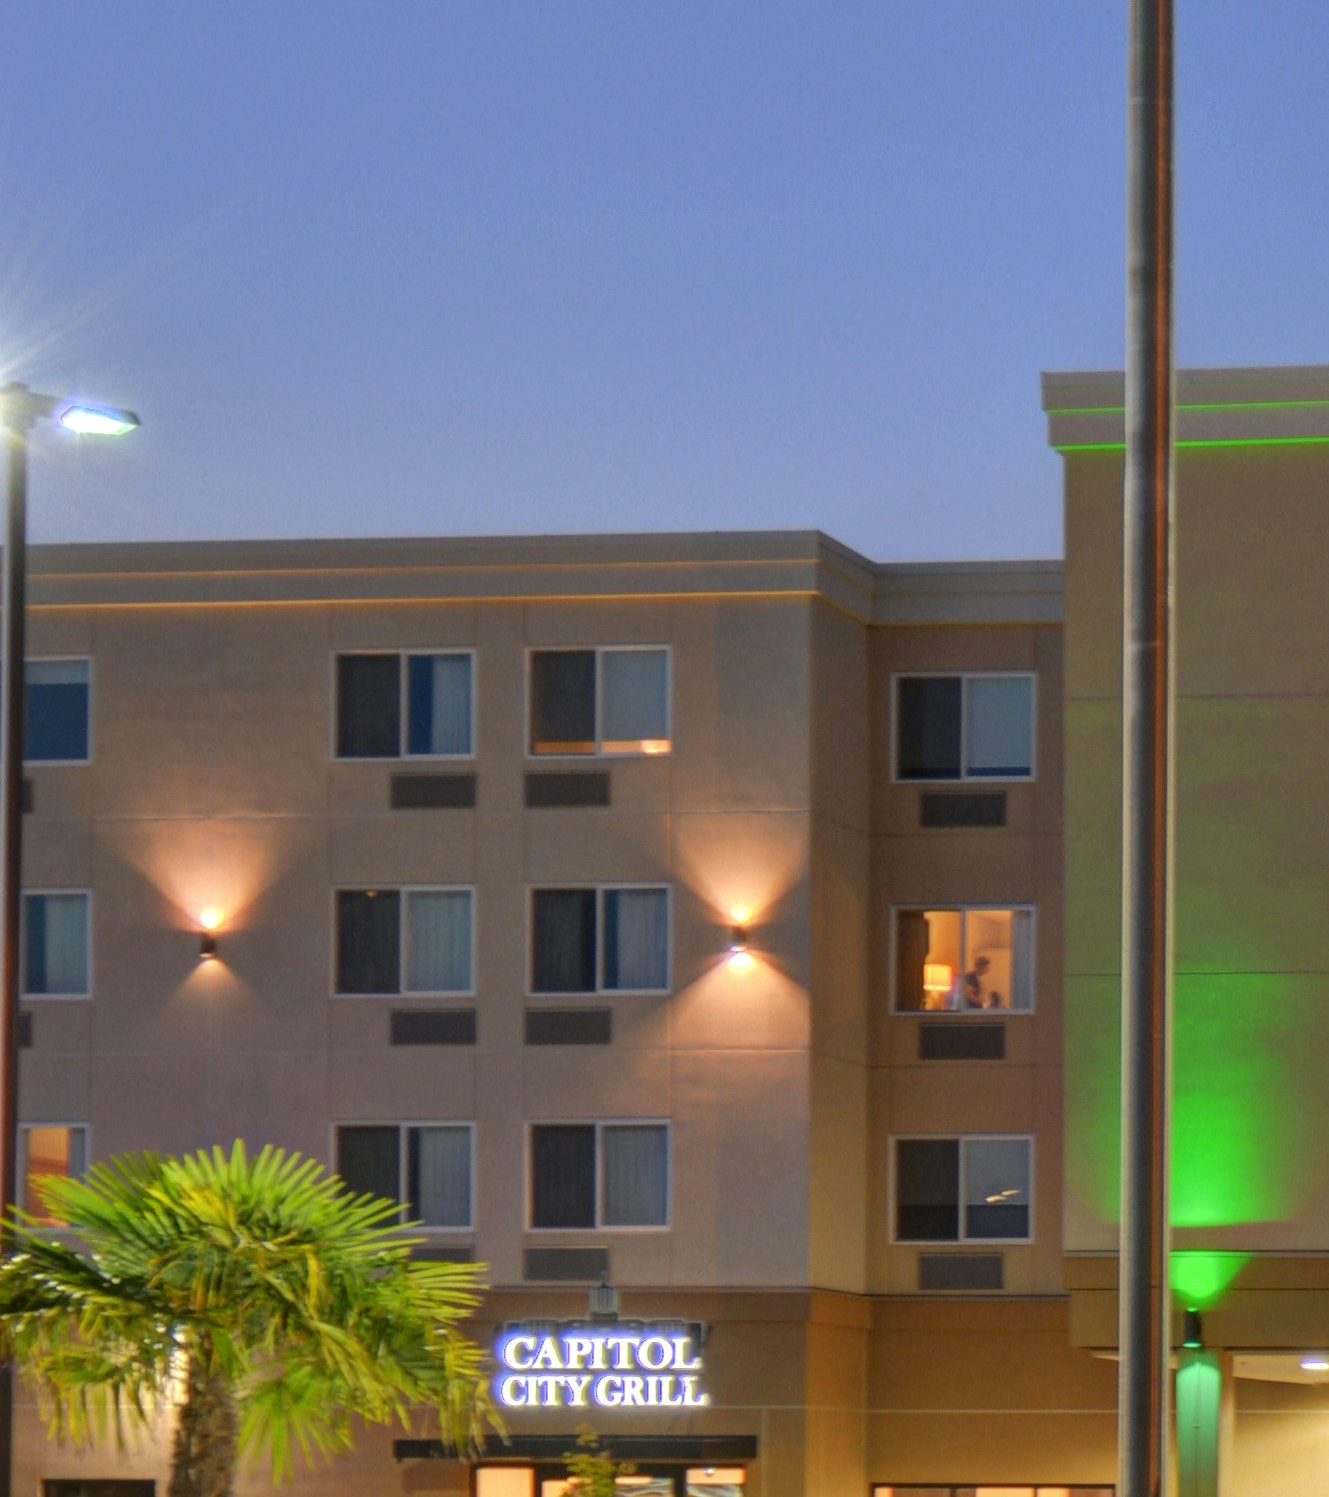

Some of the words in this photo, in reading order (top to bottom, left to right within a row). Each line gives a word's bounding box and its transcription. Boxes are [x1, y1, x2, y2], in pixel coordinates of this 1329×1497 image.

[503, 1336, 703, 1370] CAPITOL
[500, 1375, 590, 1407] CITY
[595, 1375, 708, 1407] GRILL
